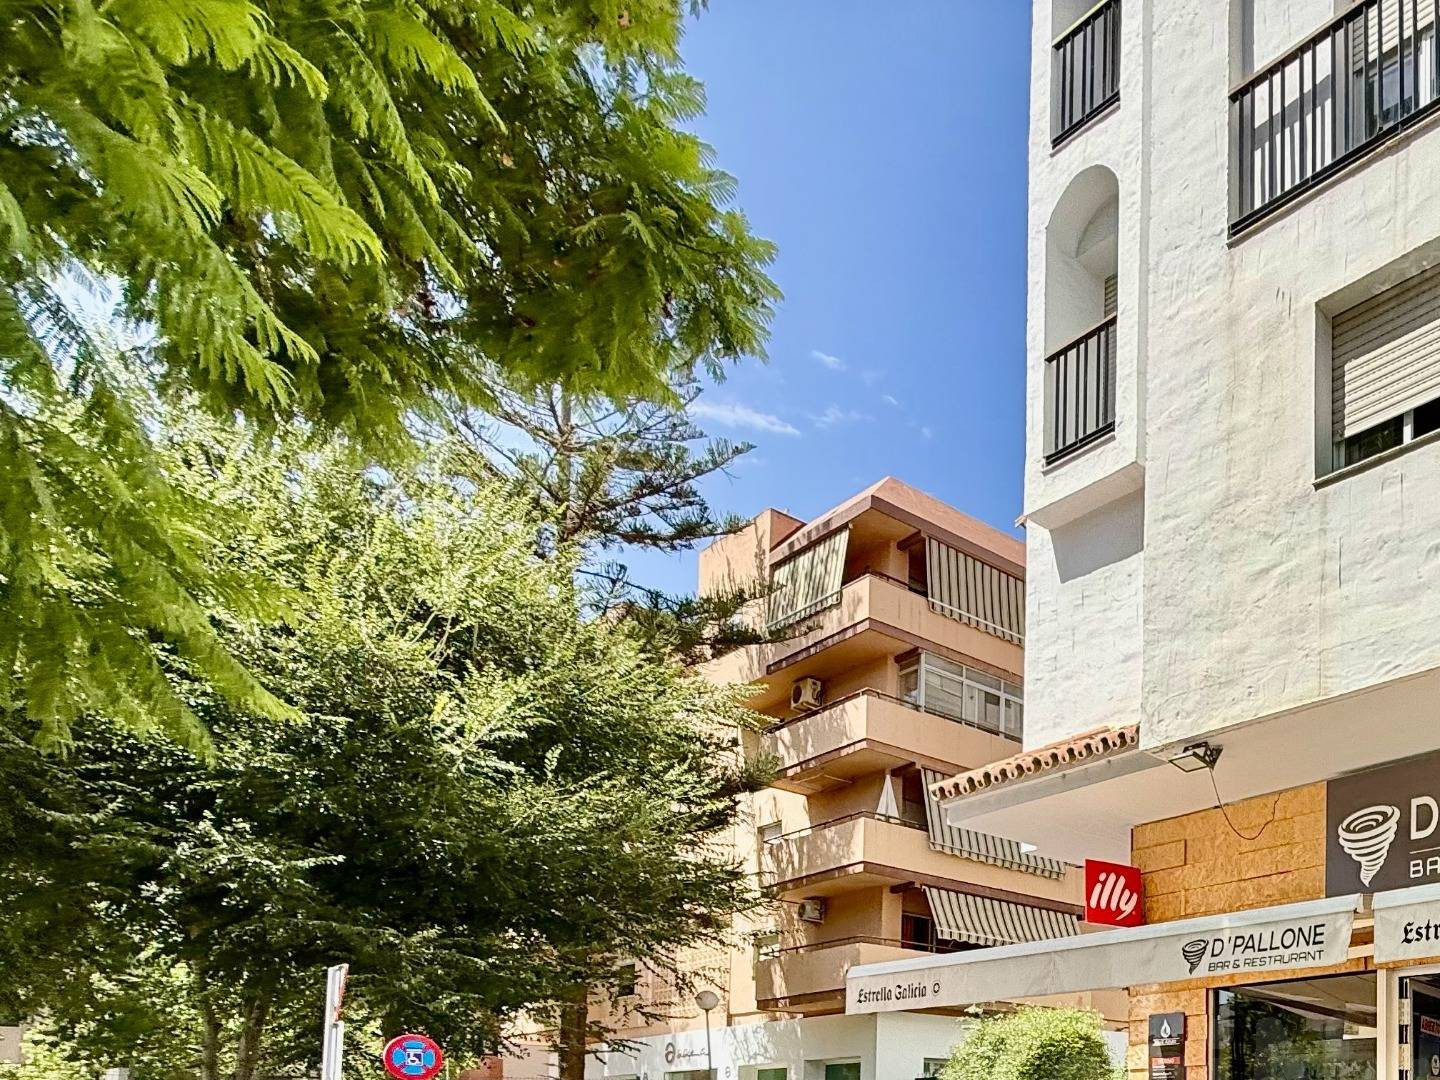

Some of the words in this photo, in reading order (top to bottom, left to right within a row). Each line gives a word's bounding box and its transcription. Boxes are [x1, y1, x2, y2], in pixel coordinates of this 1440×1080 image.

[1089, 871, 1138, 921] illy
[1210, 923, 1327, 958] D'PALLONE
[1208, 960, 1230, 972] BAR
[1232, 959, 1241, 969] &
[1243, 949, 1325, 968] RESTAURANT
[856, 986, 892, 1004] Estrella
[894, 982, 927, 1001] Galicia
